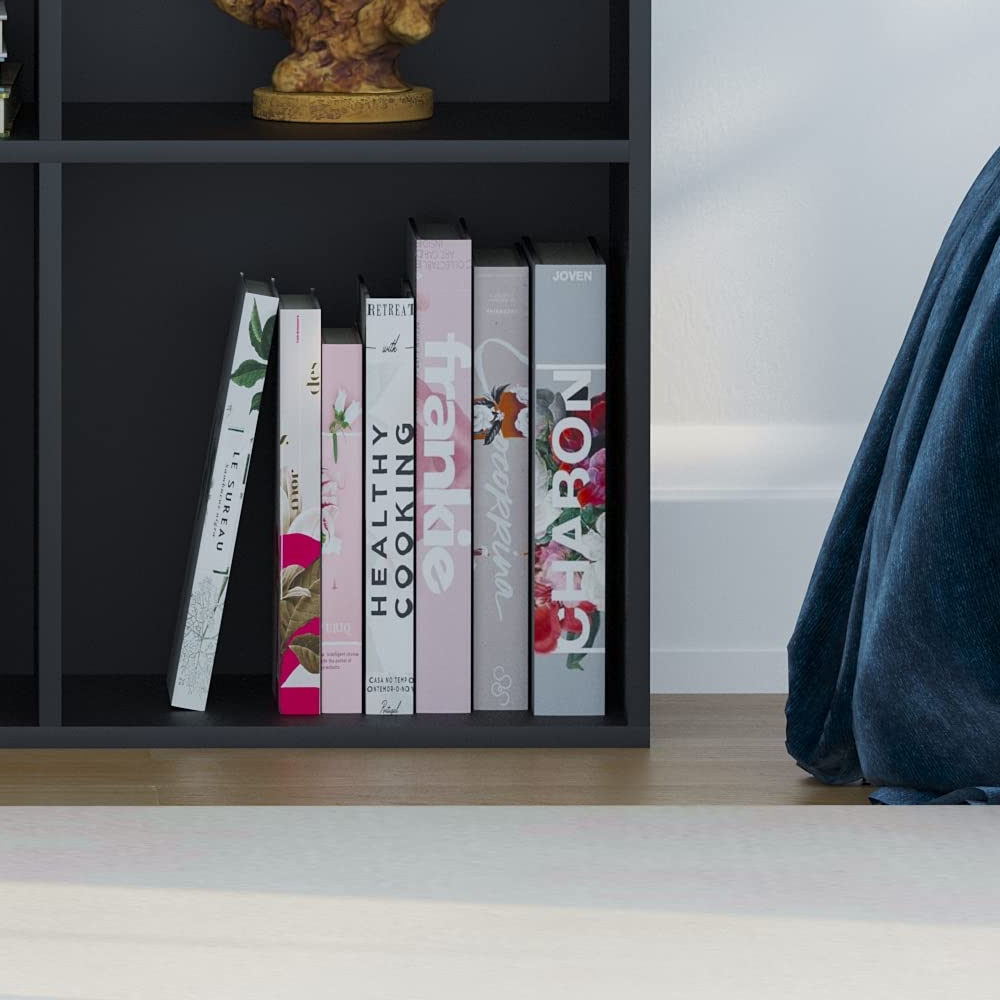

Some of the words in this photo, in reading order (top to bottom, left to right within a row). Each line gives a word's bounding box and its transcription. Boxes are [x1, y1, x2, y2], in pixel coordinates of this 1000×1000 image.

[367, 303, 414, 317] RETREAT
[552, 271, 593, 281] JOVEN
[382, 333, 401, 353] with
[231, 451, 240, 470] LE
[422, 333, 471, 595] frankie
[216, 480, 235, 551] SUREAU
[371, 424, 388, 616] HEALTHY
[395, 423, 414, 618] COOKING
[552, 369, 592, 650] CHABON
